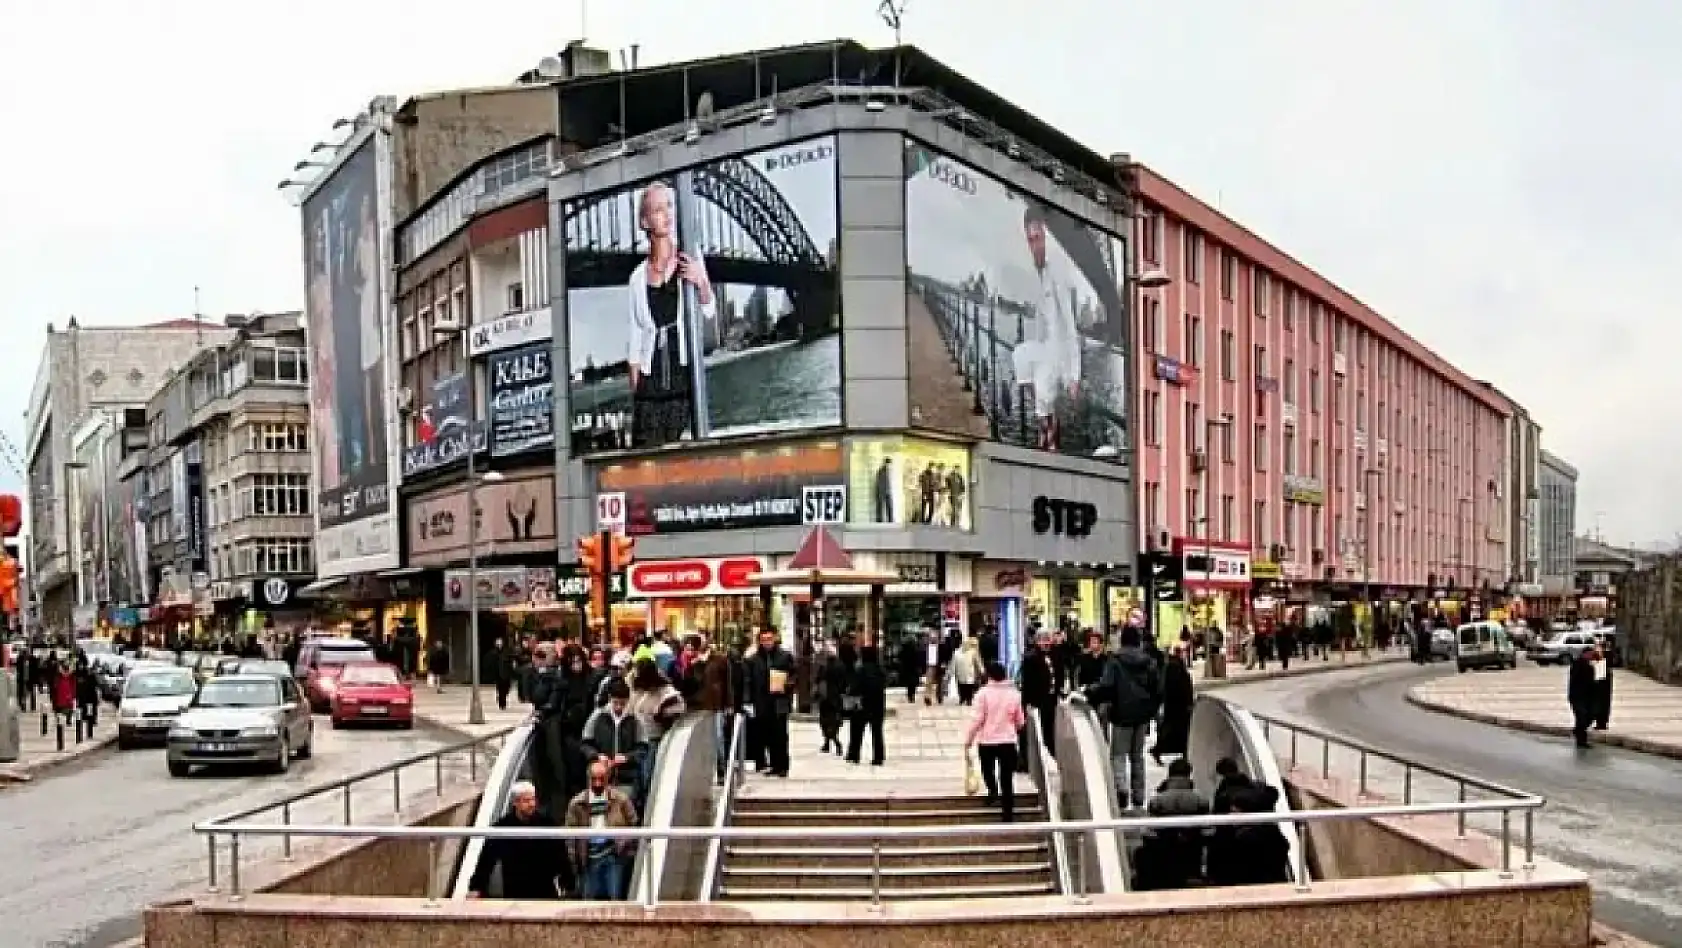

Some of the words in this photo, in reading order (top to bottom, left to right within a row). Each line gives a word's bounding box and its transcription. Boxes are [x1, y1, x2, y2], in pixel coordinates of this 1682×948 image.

[599, 497, 621, 519] 10
[804, 491, 843, 522] STEP
[1033, 495, 1098, 537] STEP
